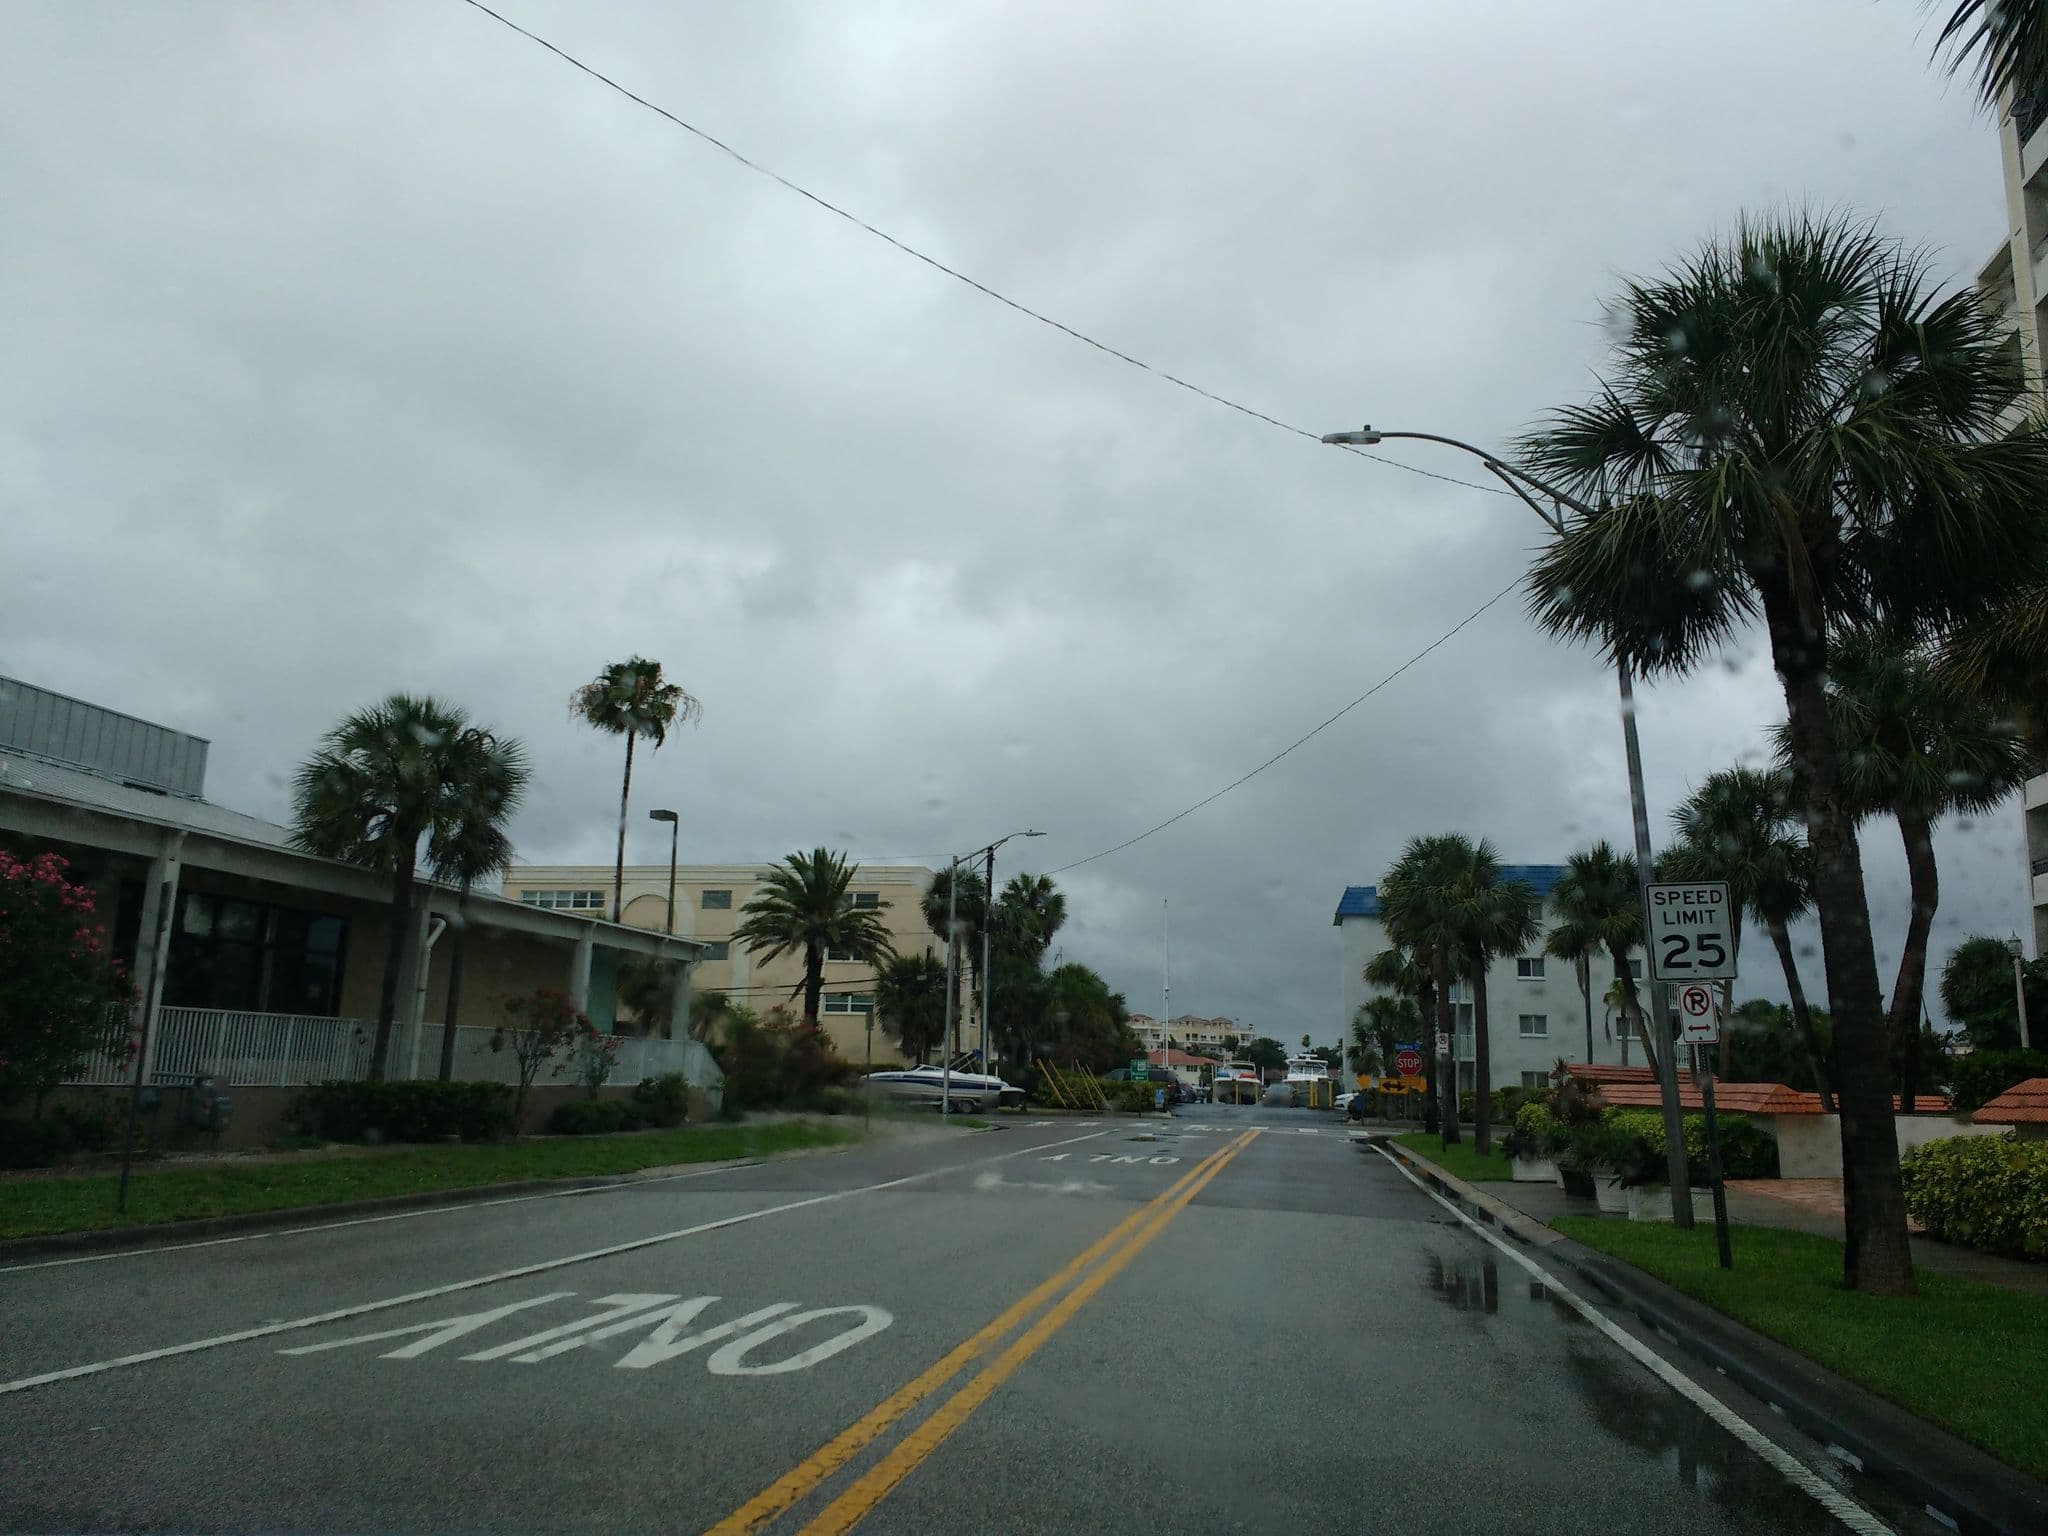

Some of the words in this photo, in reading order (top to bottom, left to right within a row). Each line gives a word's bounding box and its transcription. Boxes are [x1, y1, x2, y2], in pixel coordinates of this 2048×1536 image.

[1654, 890, 1723, 906] SPEED
[1663, 909, 1716, 925] LIMIT
[1661, 933, 1726, 968] 25
[1689, 991, 1705, 1011] P
[1398, 1058, 1420, 1068] STOP
[275, 1292, 895, 1376] ONLY
